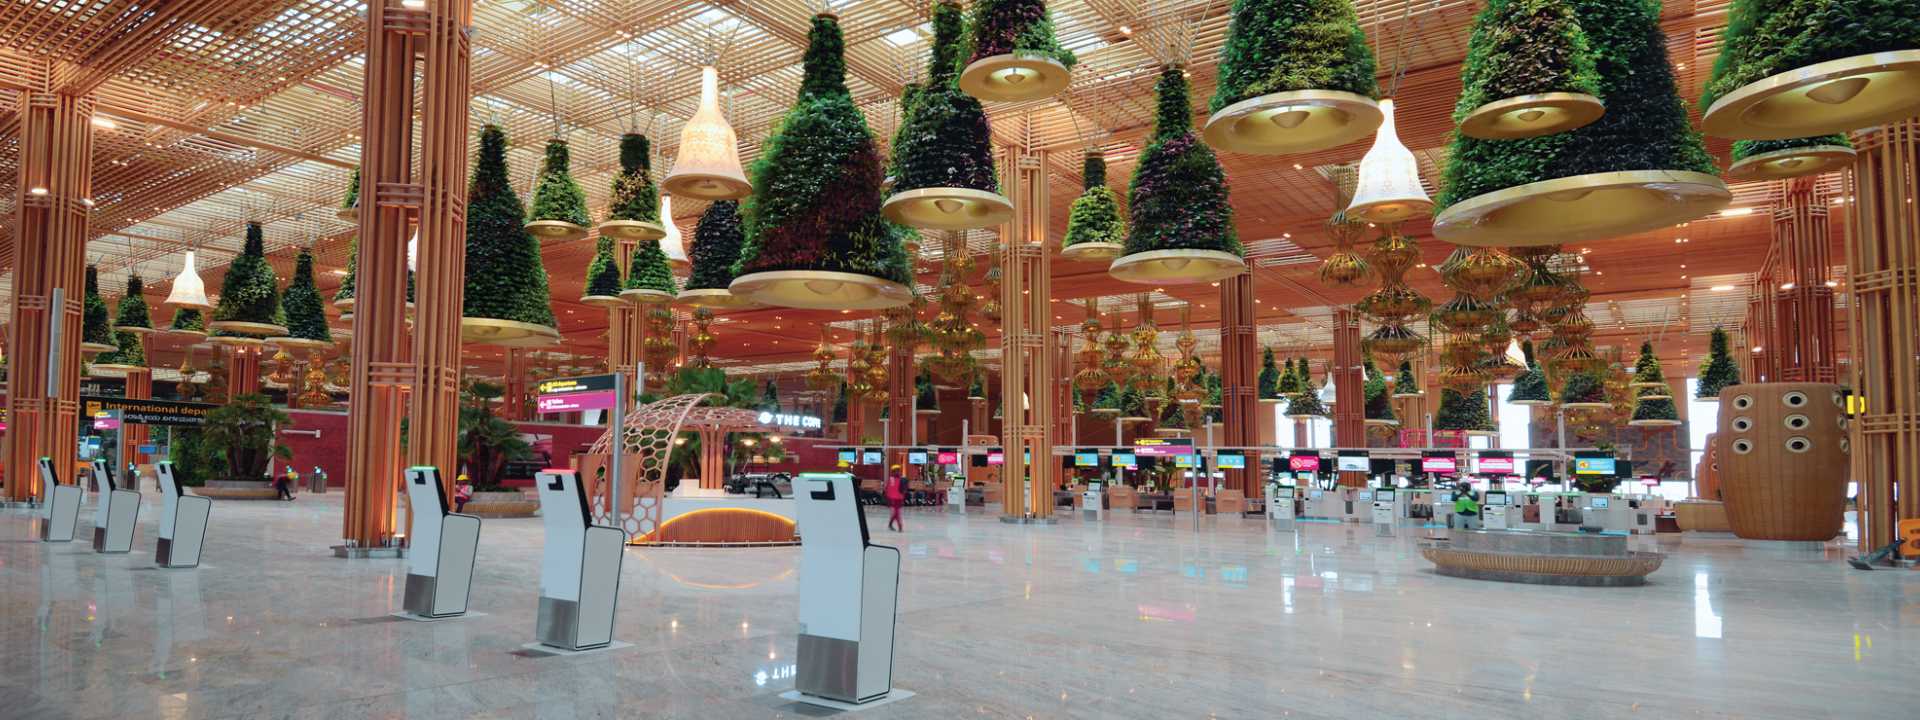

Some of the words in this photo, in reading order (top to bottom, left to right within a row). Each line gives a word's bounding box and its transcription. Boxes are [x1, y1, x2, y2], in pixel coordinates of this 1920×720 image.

[106, 402, 178, 414] International
[180, 407, 209, 416] depa
[776, 414, 799, 426] THE
